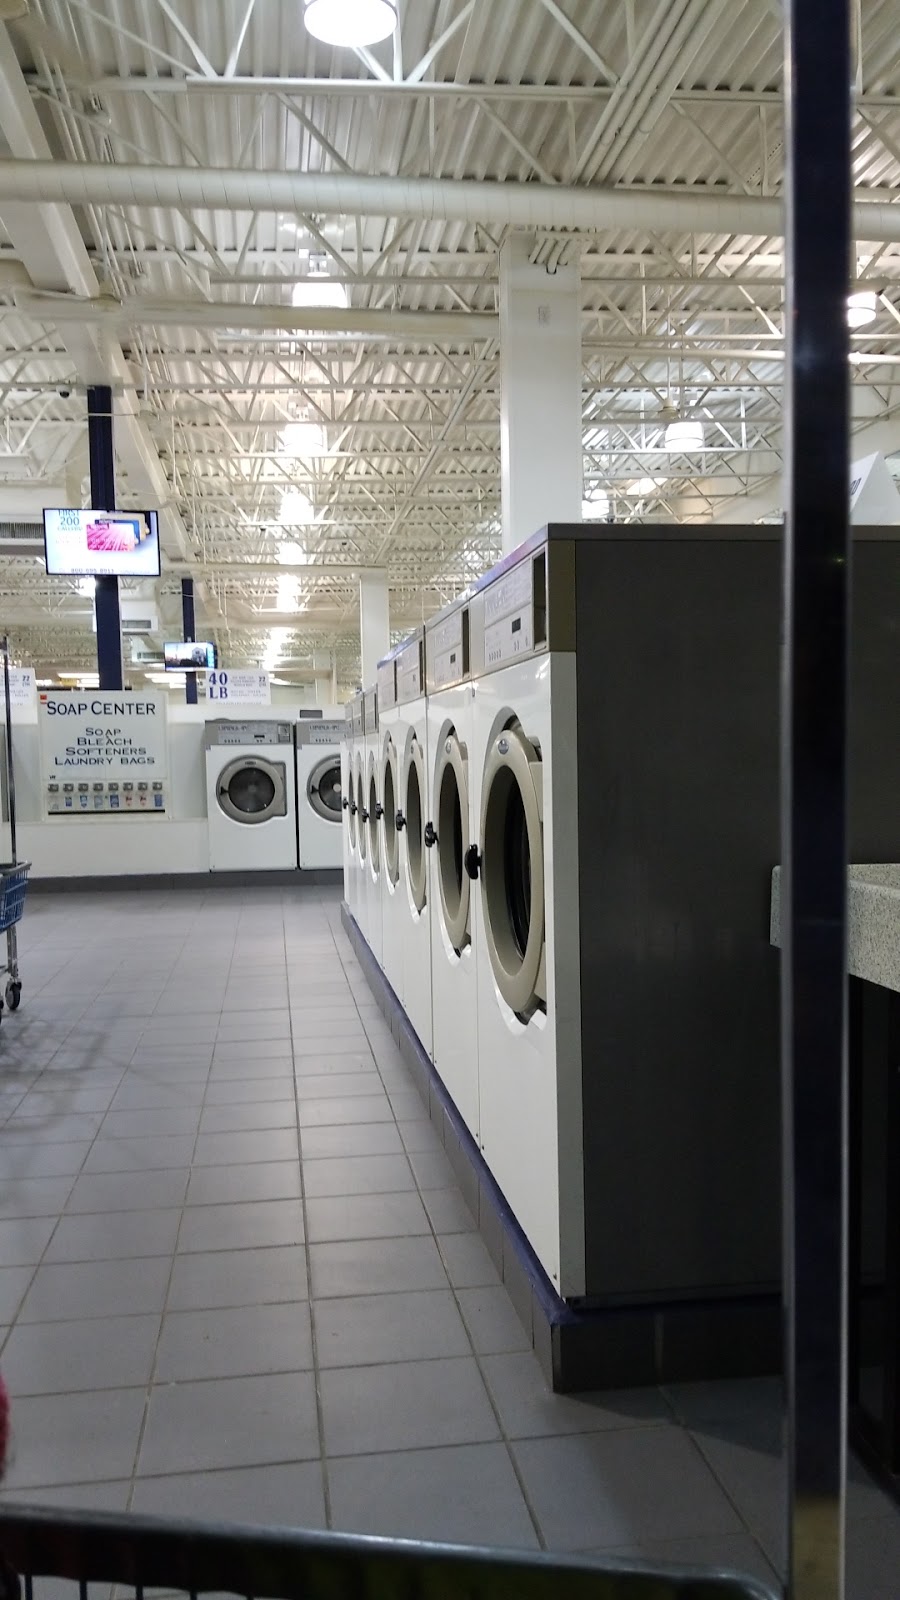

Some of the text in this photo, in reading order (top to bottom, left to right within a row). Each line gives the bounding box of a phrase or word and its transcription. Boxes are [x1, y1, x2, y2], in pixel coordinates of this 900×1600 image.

[60, 517, 79, 526] 200
[209, 672, 228, 685] 40
[209, 687, 228, 699] LB
[47, 701, 156, 715] SOAP CENTER
[85, 727, 121, 736] SOAP
[77, 737, 132, 746] BLEACH
[65, 747, 147, 756] SOFTENERS
[54, 756, 155, 766] LAUNDRY BAGS
